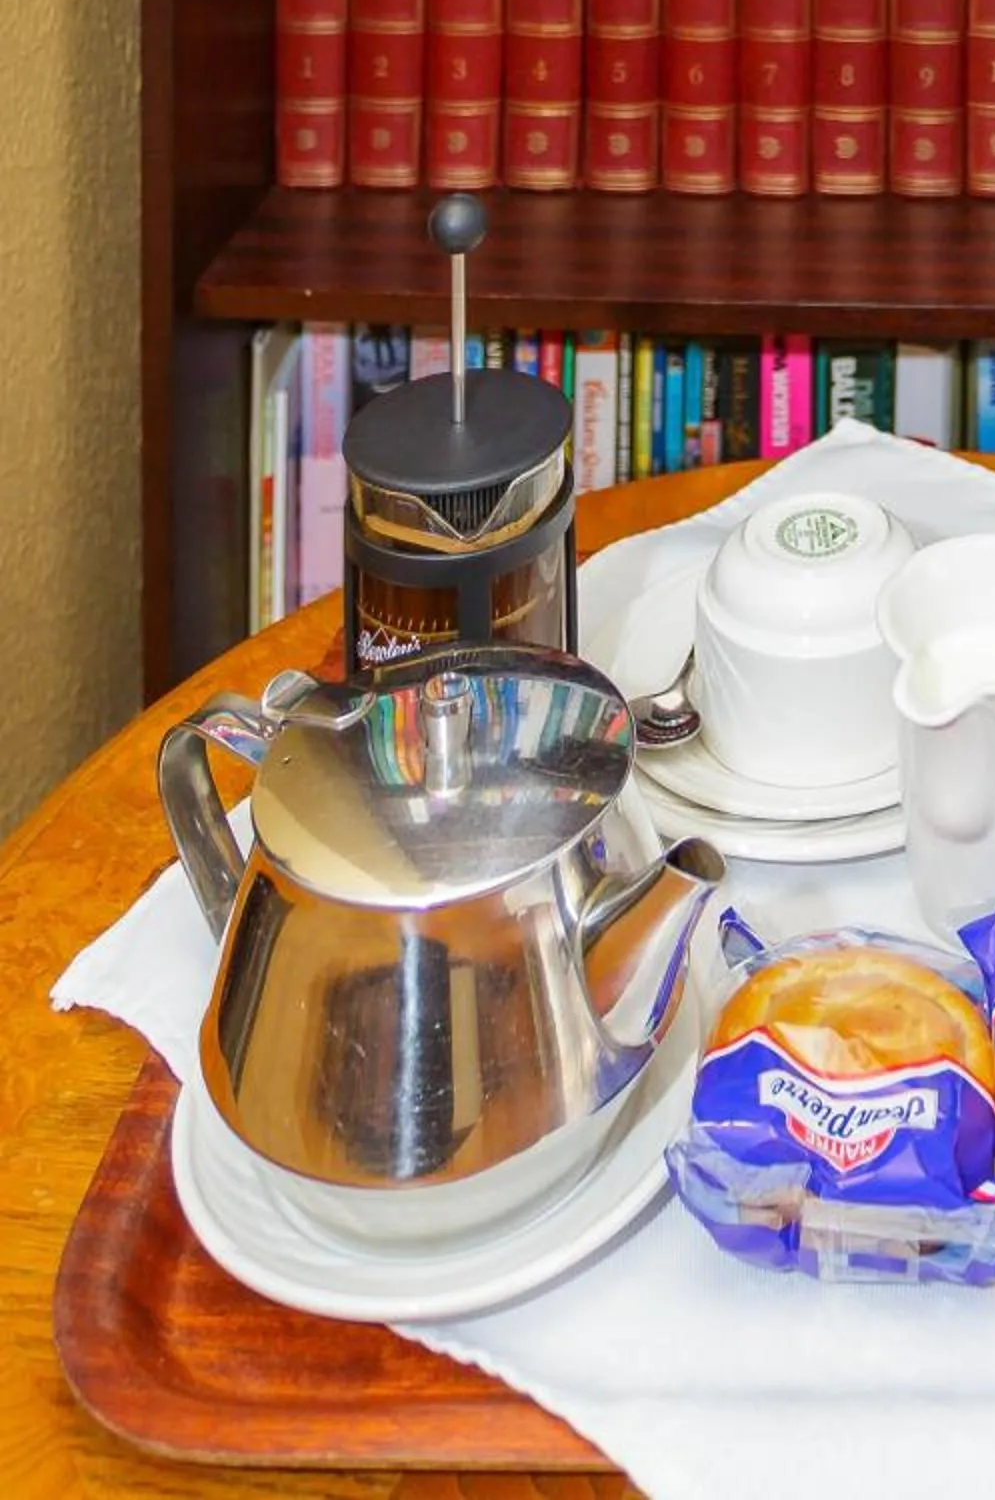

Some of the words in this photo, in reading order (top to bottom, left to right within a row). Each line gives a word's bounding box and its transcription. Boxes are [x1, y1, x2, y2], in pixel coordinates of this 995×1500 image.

[374, 56, 388, 76] 2
[453, 58, 466, 78] 3
[532, 60, 547, 81] 4
[612, 62, 626, 83] 5
[688, 65, 703, 85] 6
[762, 64, 778, 85] 7
[840, 64, 855, 86] 8
[919, 67, 934, 88] 9
